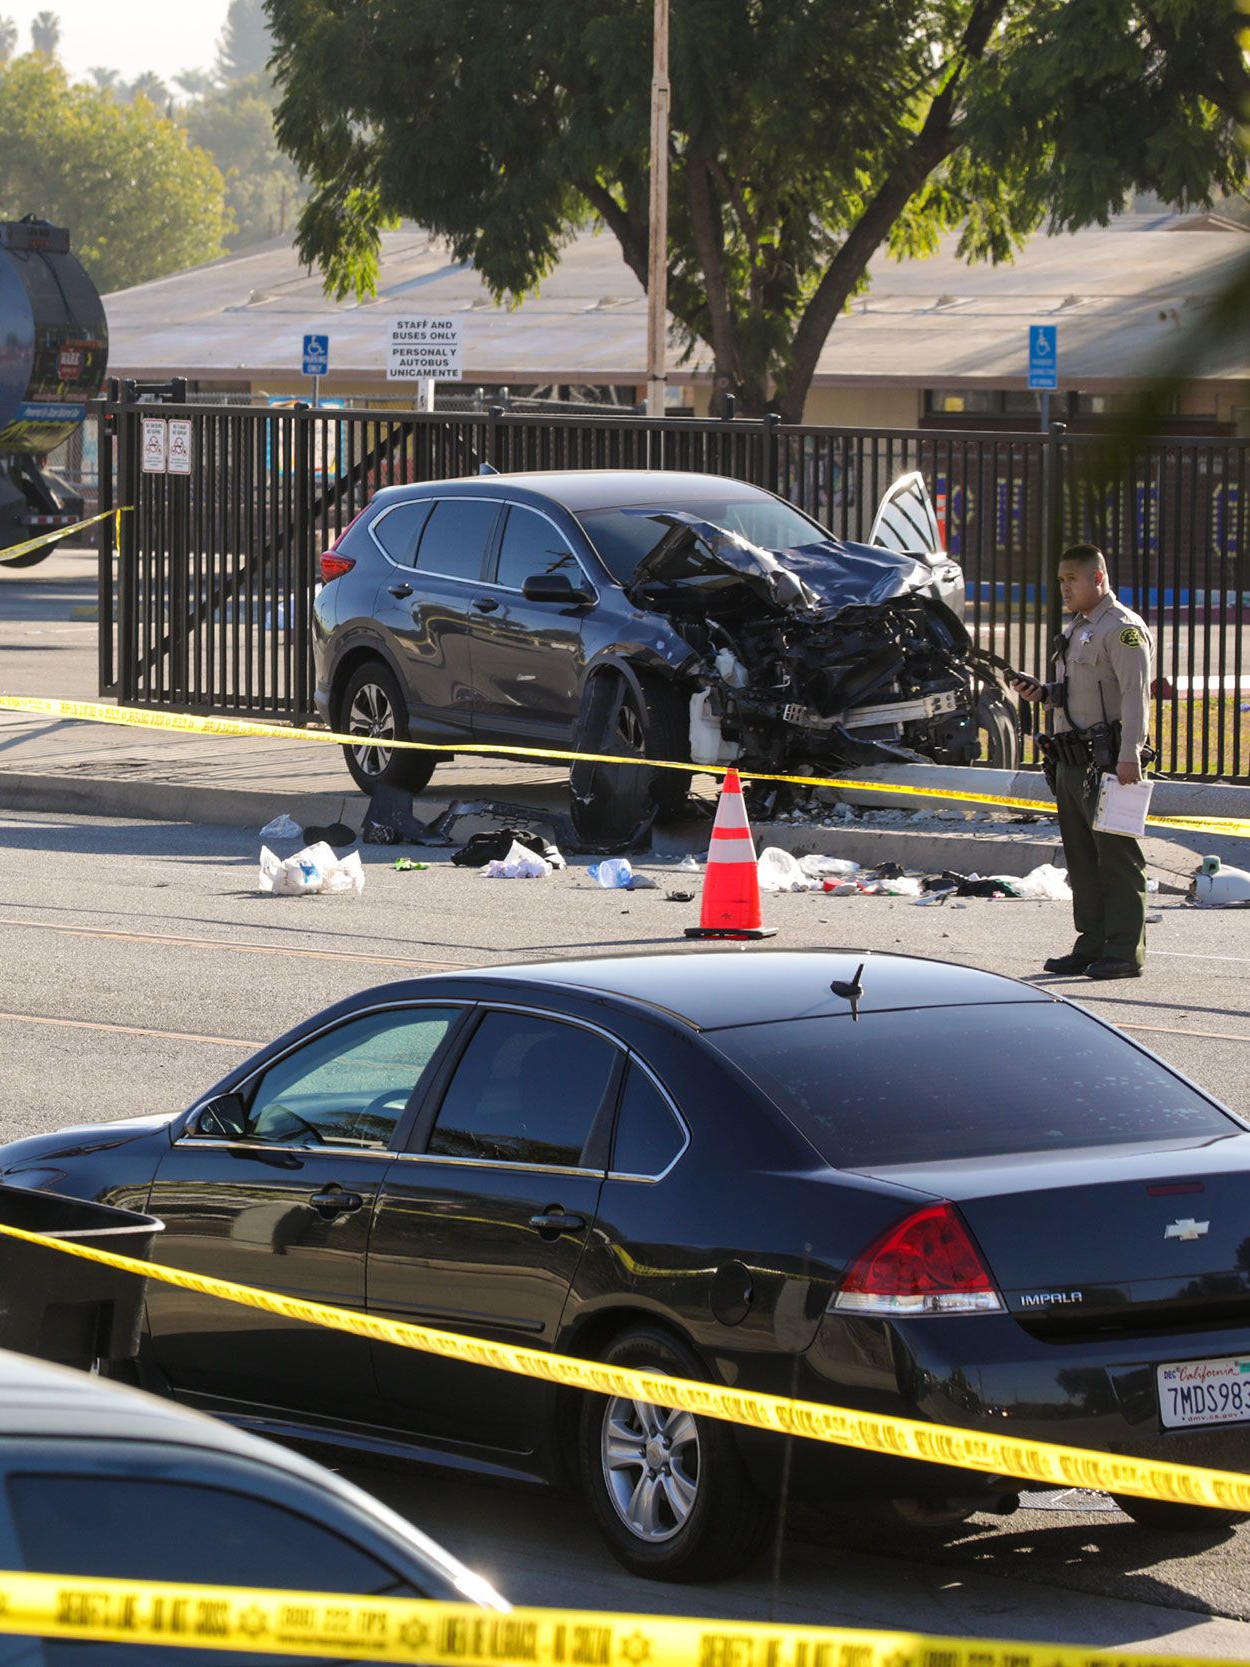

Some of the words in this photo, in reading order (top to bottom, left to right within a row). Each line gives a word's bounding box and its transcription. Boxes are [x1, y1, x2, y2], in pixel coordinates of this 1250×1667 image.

[1021, 1292, 1082, 1306] IMPALA
[1164, 1370, 1176, 1379] DEC
[1180, 1366, 1240, 1382] California
